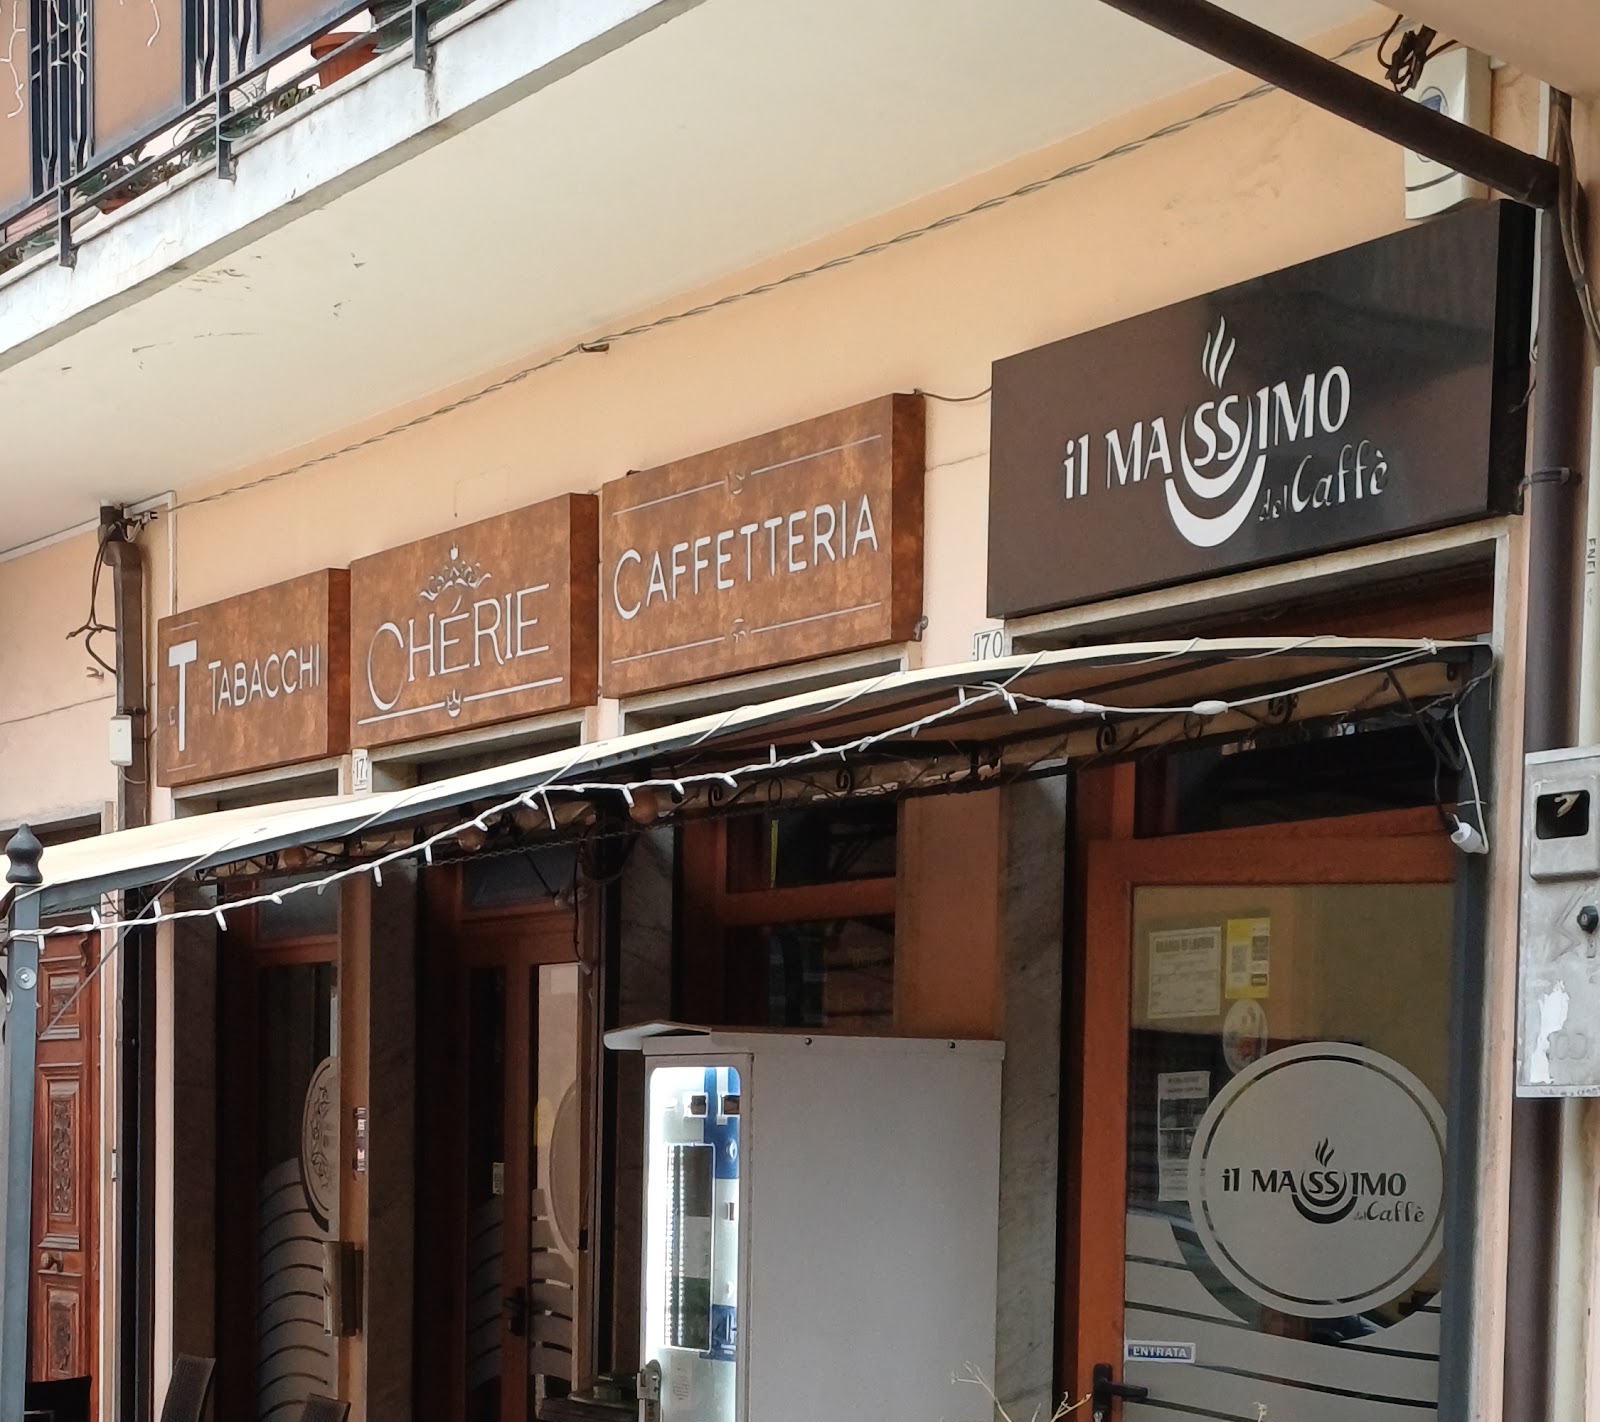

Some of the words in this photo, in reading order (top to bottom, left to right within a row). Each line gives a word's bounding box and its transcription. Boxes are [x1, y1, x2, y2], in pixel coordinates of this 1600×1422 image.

[1063, 433, 1089, 499] il
[1104, 365, 1350, 490] MASSIMO
[1290, 439, 1389, 513] Caffè
[612, 493, 879, 620] CAFFETTERIA
[367, 583, 550, 711] CHÉRIE
[976, 631, 1003, 661] 170
[168, 639, 198, 752] T
[208, 642, 320, 717] TABACCHI
[1221, 1167, 1240, 1192] il
[1251, 1169, 1407, 1197] MASSIMO
[1366, 1200, 1425, 1223] Caffè
[1132, 1345, 1188, 1358] ENTRATA
